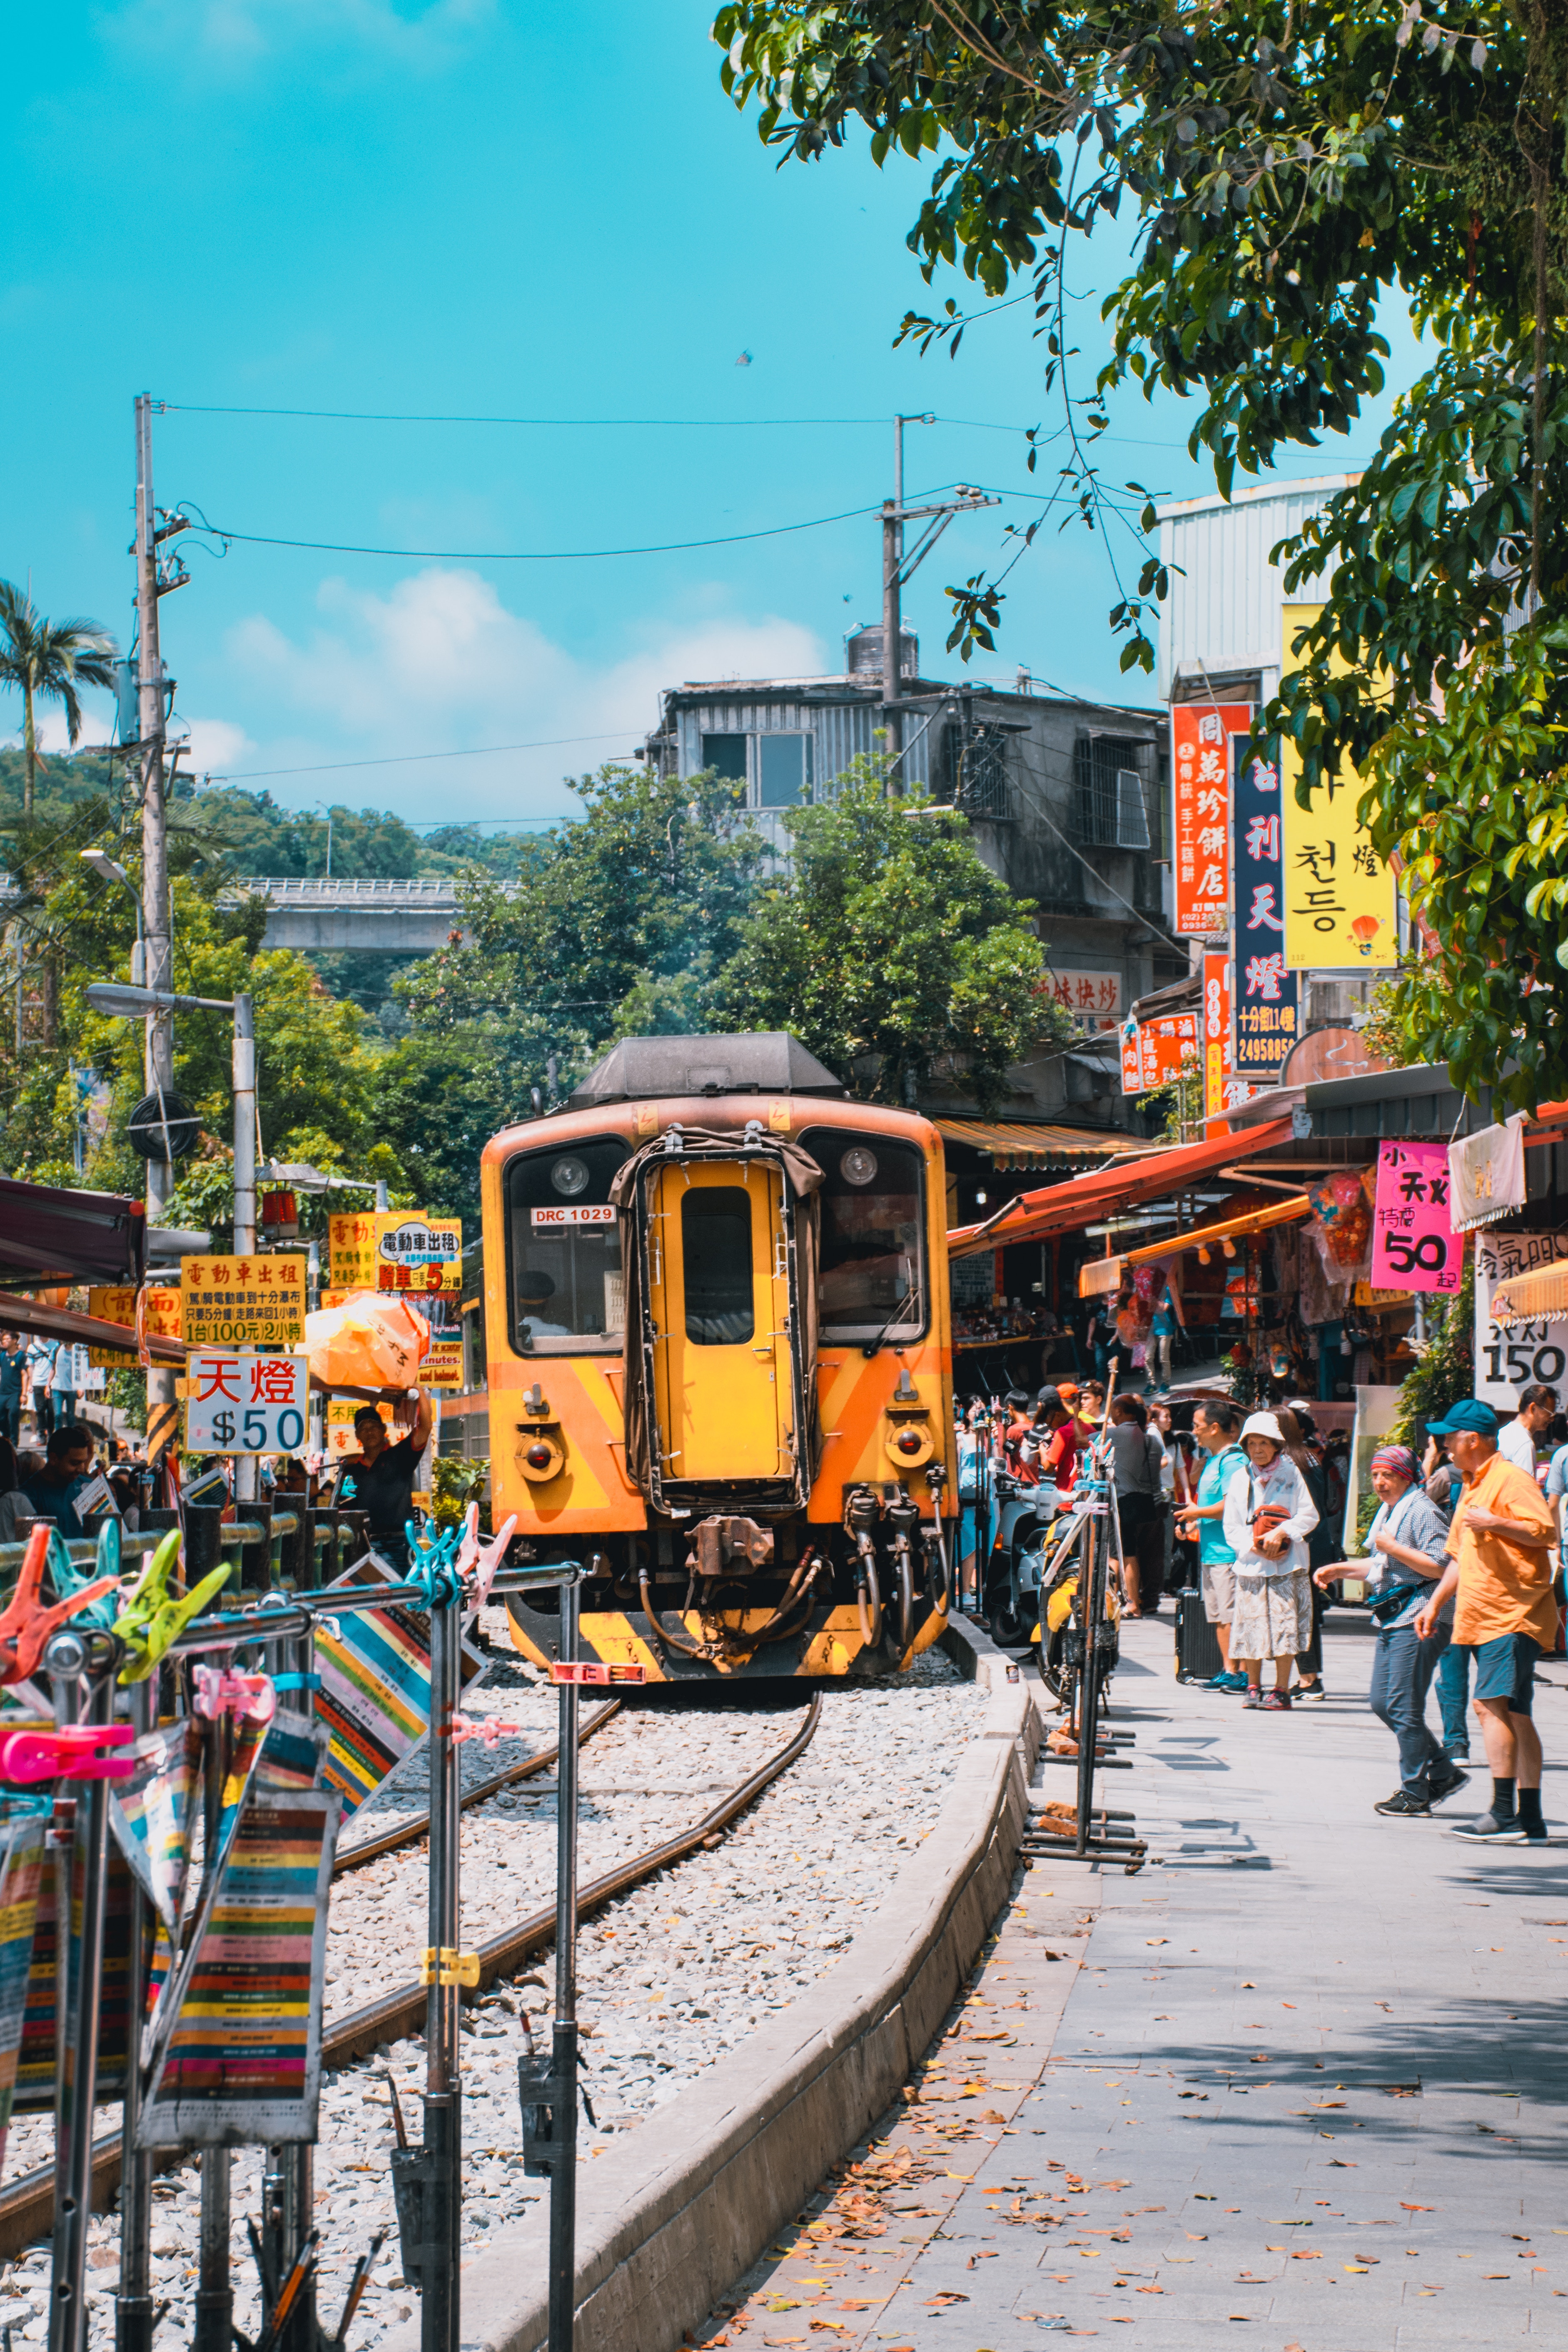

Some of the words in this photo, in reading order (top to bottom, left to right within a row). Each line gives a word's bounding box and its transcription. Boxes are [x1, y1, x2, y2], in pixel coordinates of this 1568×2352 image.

[1239, 1006, 1295, 1032] 十分街114號
[536, 1210, 565, 1222] DRC
[571, 1208, 612, 1220] 1029
[383, 1232, 455, 1252] 電動車出租
[1385, 1230, 1448, 1273] 50
[188, 1262, 299, 1287] 電動車出租
[1437, 1271, 1457, 1288] 起
[1482, 1344, 1566, 1384] 150
[196, 1359, 297, 1404] 天燈
[212, 1409, 304, 1450] $50
